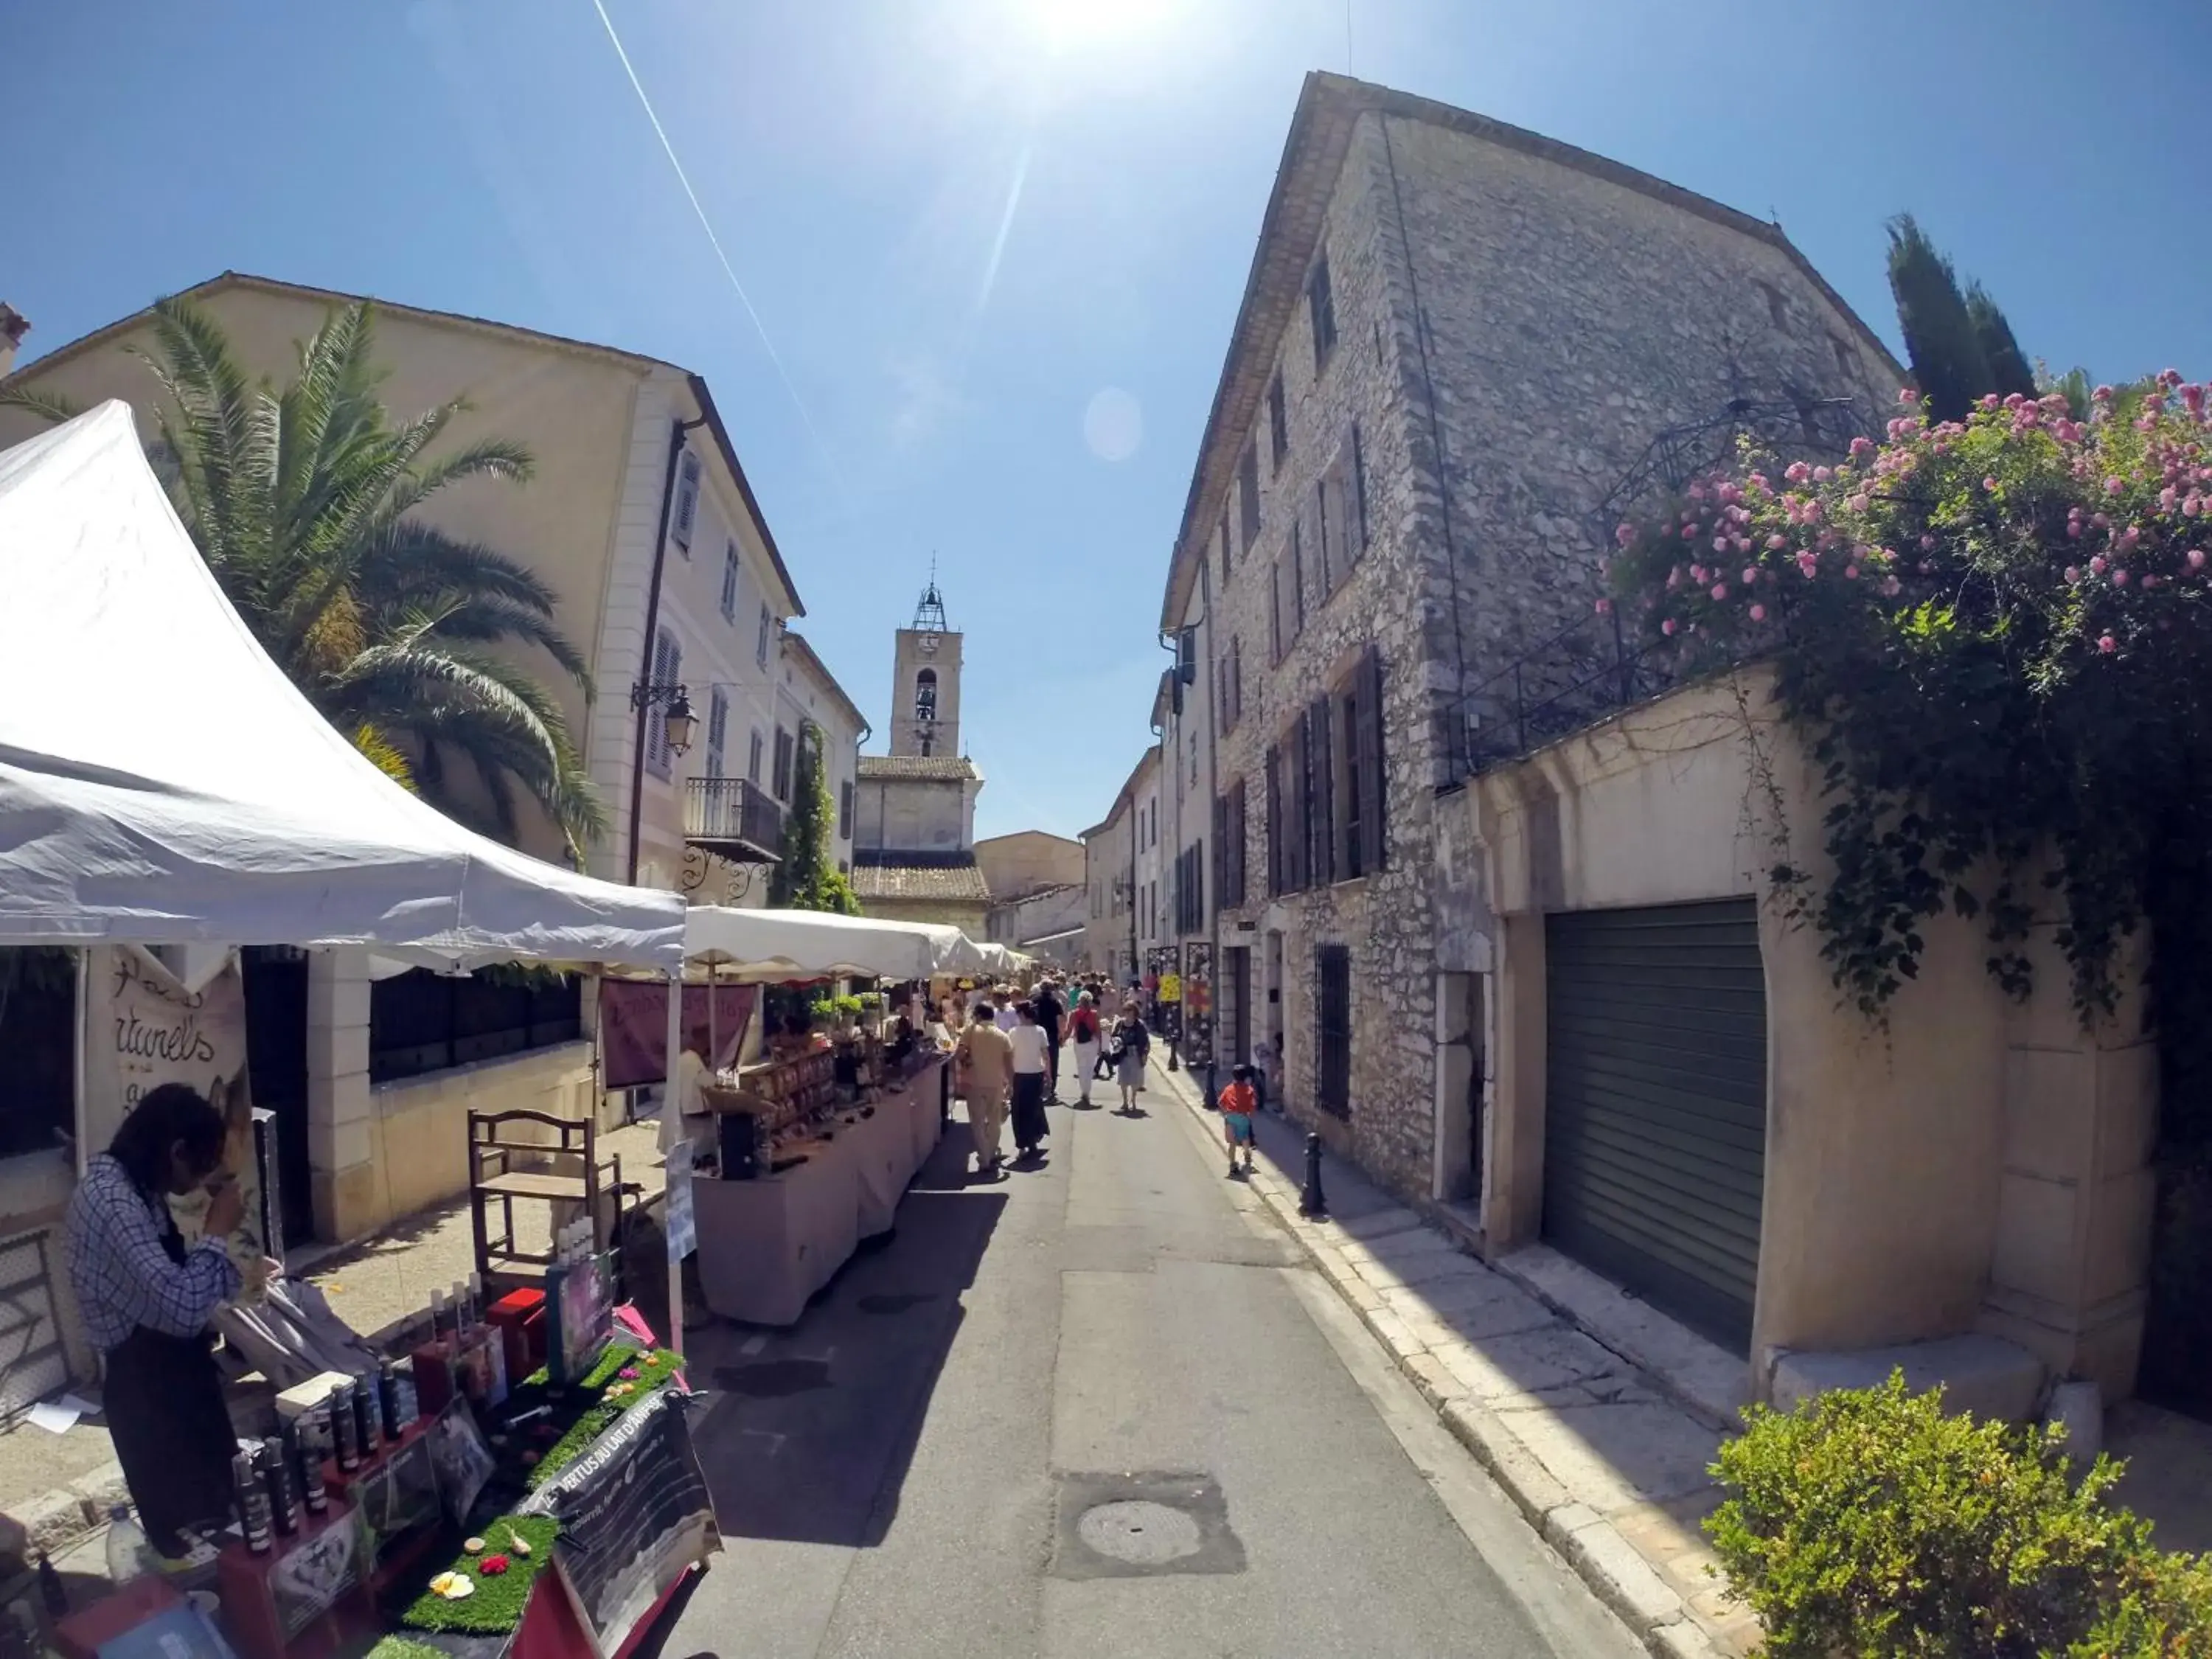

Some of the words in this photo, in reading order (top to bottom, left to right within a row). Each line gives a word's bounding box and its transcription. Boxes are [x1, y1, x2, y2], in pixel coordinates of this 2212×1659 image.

[558, 1455, 599, 1492] VERTUS
[596, 1445, 611, 1464] DU
[609, 1429, 628, 1452] LAIT
